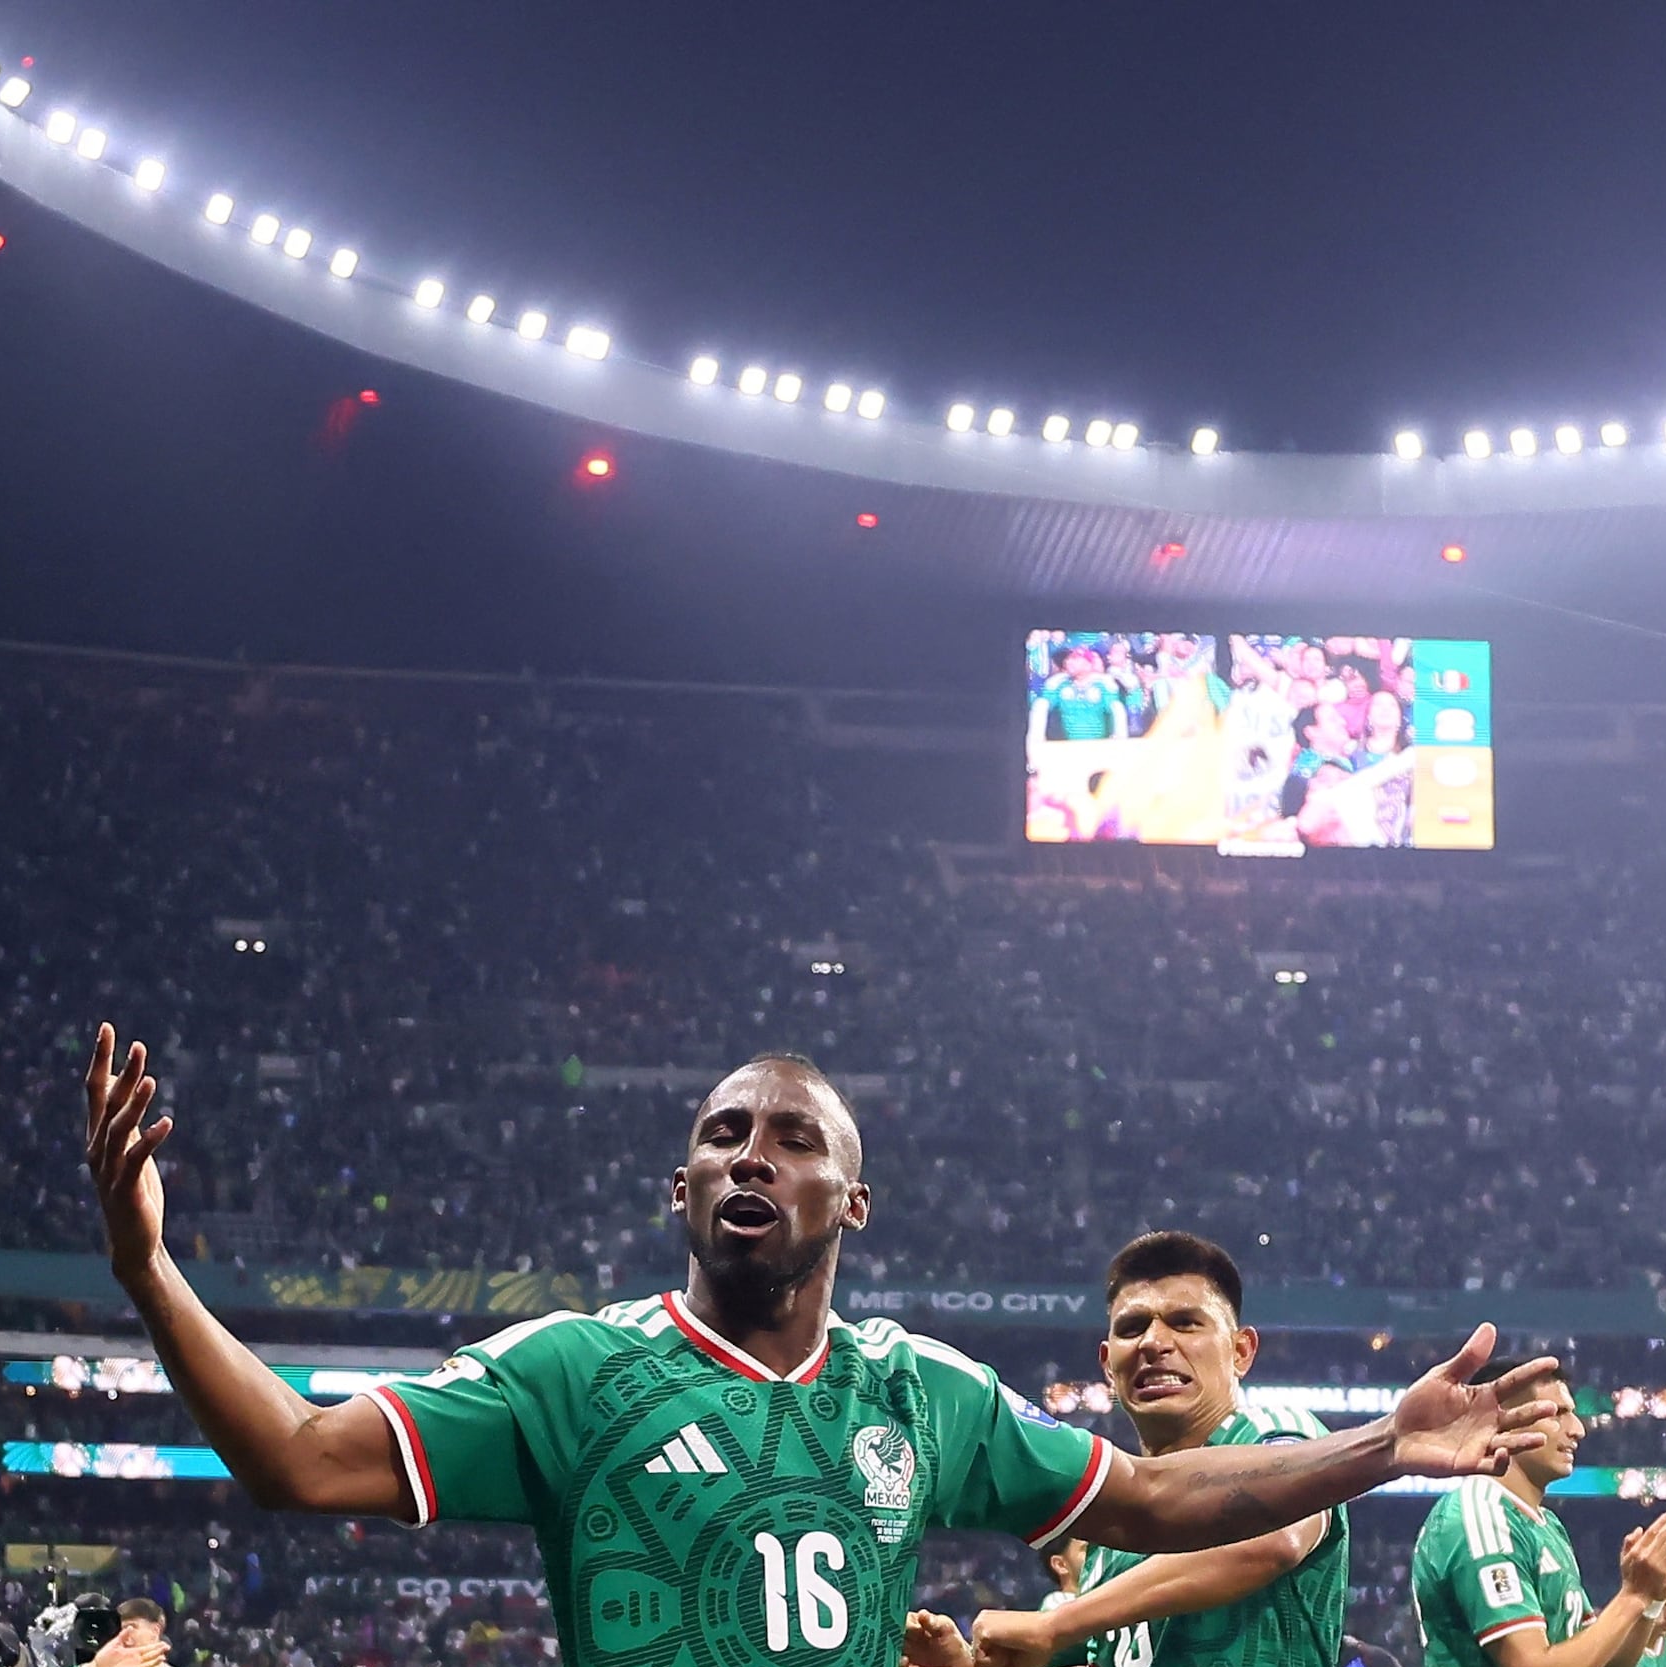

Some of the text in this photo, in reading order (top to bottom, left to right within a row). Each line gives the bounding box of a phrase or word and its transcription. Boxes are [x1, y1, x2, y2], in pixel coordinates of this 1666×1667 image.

[848, 1290, 1085, 1314] MEICO CITY
[866, 1489, 909, 1507] MÉXICO
[753, 1531, 850, 1653] 16
